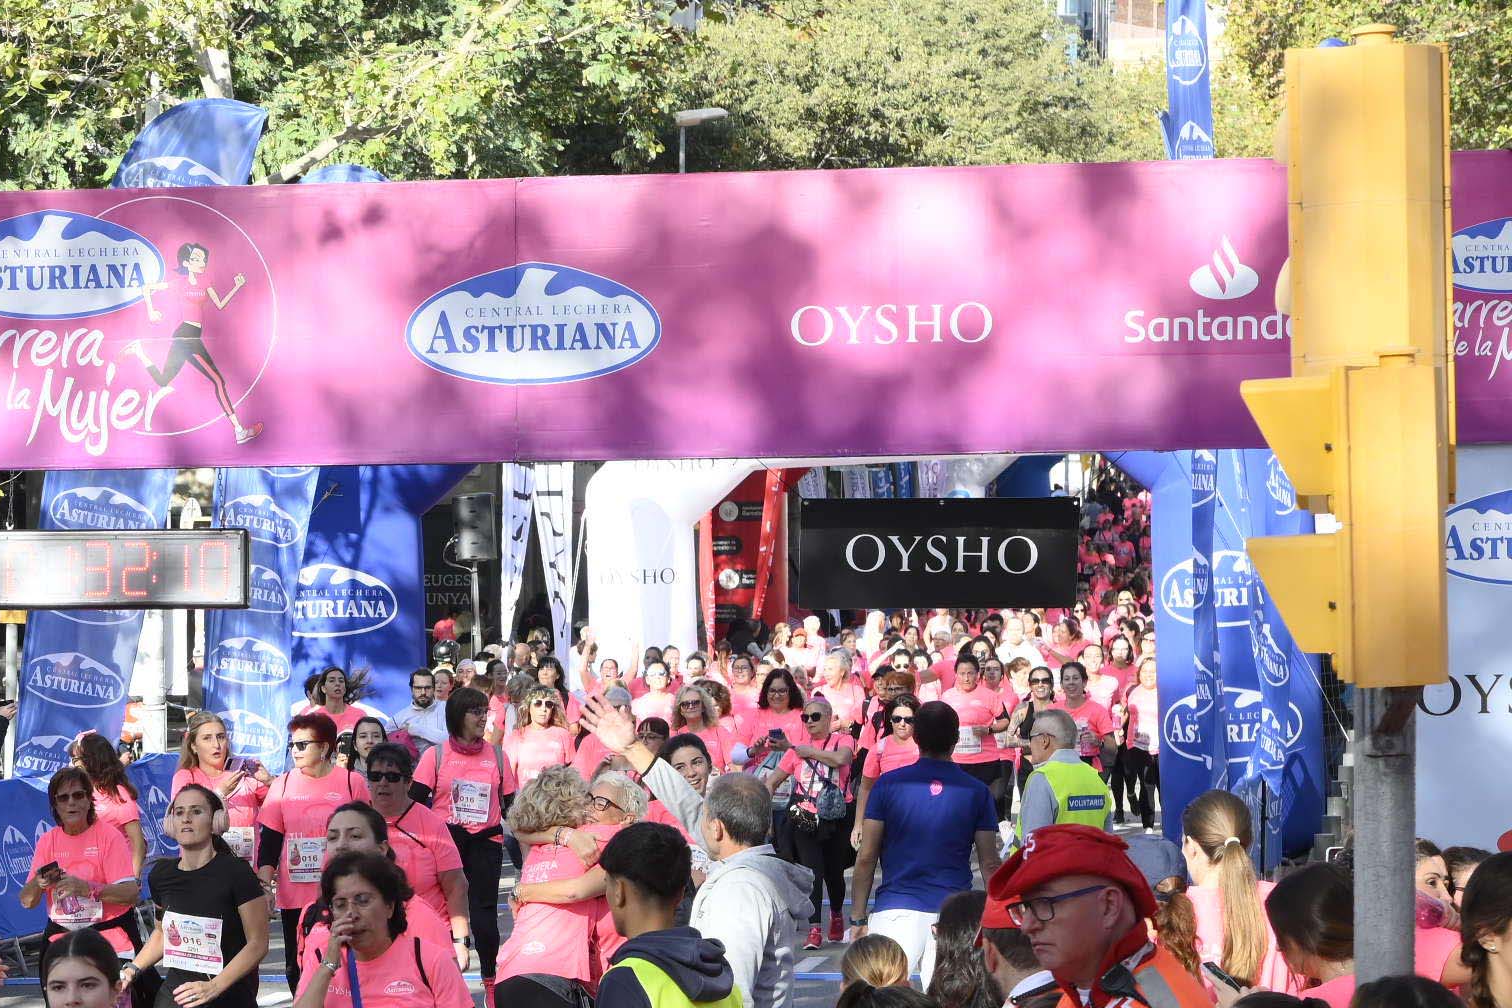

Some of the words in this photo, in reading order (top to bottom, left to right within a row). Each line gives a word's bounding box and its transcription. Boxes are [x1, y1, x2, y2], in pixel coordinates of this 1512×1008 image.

[67, 247, 142, 258] LECHERA
[465, 305, 544, 318] CENTRAL
[550, 303, 633, 316] LECHERA
[790, 301, 993, 347] OYSHO
[426, 309, 642, 355] ASTURIANA
[1474, 329, 1493, 356] la
[6, 371, 31, 410] la
[26, 363, 175, 456] Mujer
[225, 508, 292, 541] ASTURINA
[845, 533, 1039, 575] OYSHO
[334, 588, 384, 597] LECHERA
[295, 599, 388, 619] TURIANA
[28, 665, 115, 701] ASTURIANA
[214, 658, 286, 679] STURIANA
[1417, 674, 1512, 717] OY
[328, 984, 353, 997] OYSH
